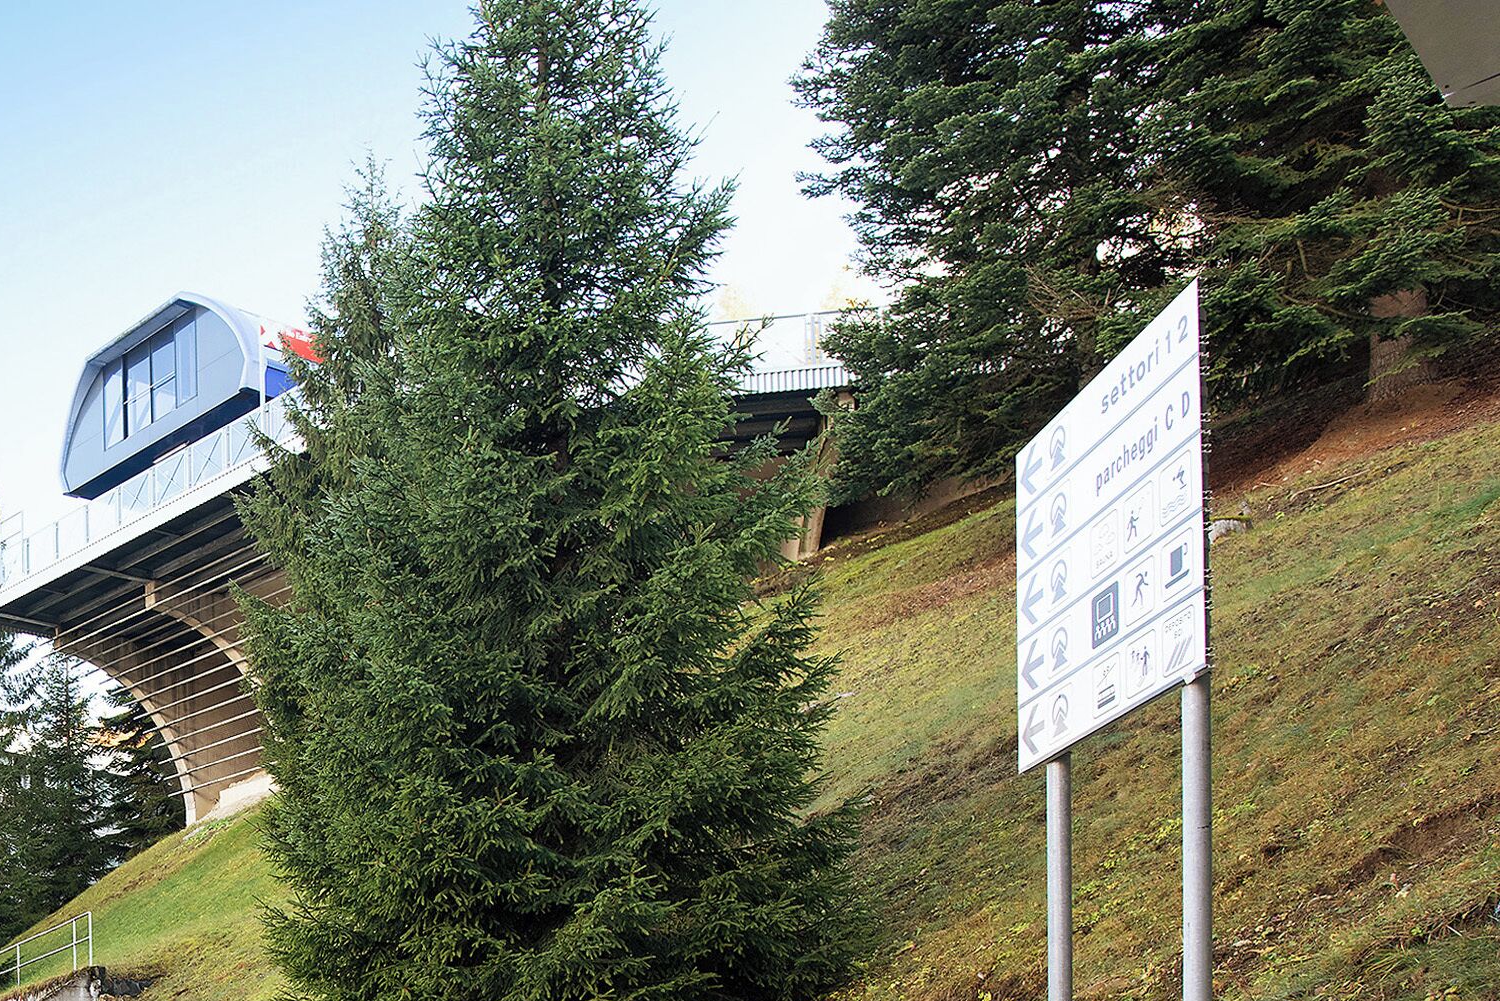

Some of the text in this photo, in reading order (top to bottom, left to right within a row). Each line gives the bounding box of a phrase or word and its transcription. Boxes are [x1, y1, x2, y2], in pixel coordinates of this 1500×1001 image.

[1101, 315, 1189, 414] settori 1 2
[1095, 391, 1190, 497] parcheggi C D
